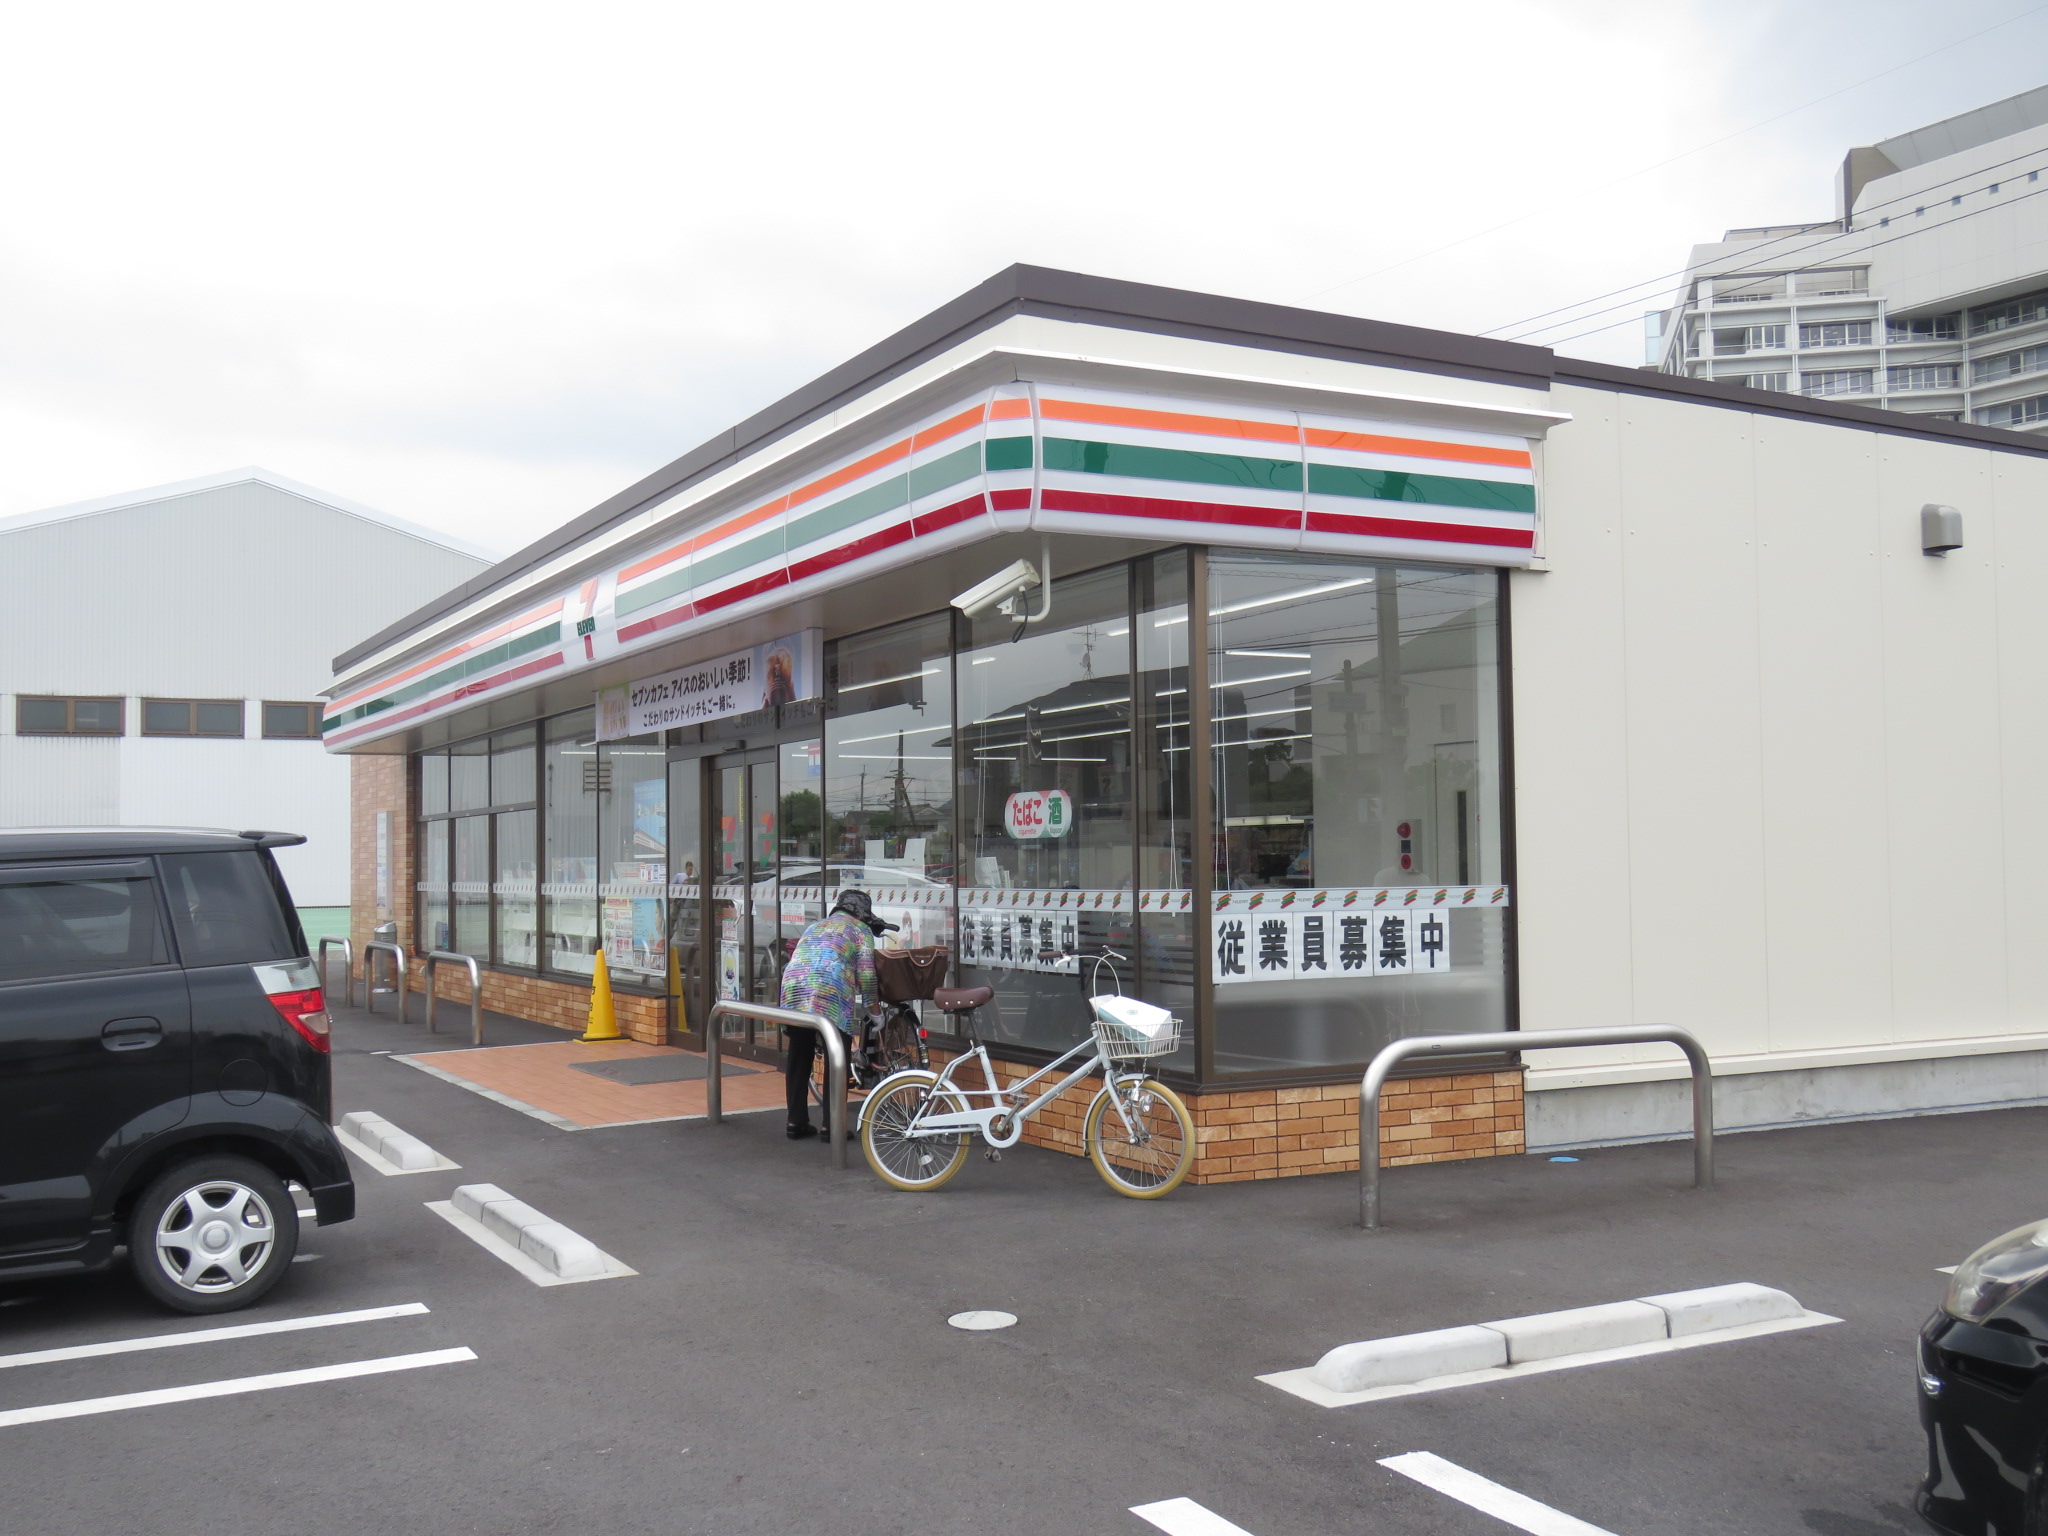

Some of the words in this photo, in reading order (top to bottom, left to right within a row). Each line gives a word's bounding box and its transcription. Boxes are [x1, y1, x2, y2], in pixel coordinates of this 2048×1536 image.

[631, 684, 668, 708] セブンカフェ
[643, 694, 736, 728] こだわりのサンドイッチもご一緒に。
[1012, 798, 1043, 826] たばこ
[1048, 797, 1062, 825] 酒
[1018, 828, 1037, 836] cigarette
[963, 913, 1074, 969] 従業員募集中
[1217, 912, 1444, 977] 従業員募集中
